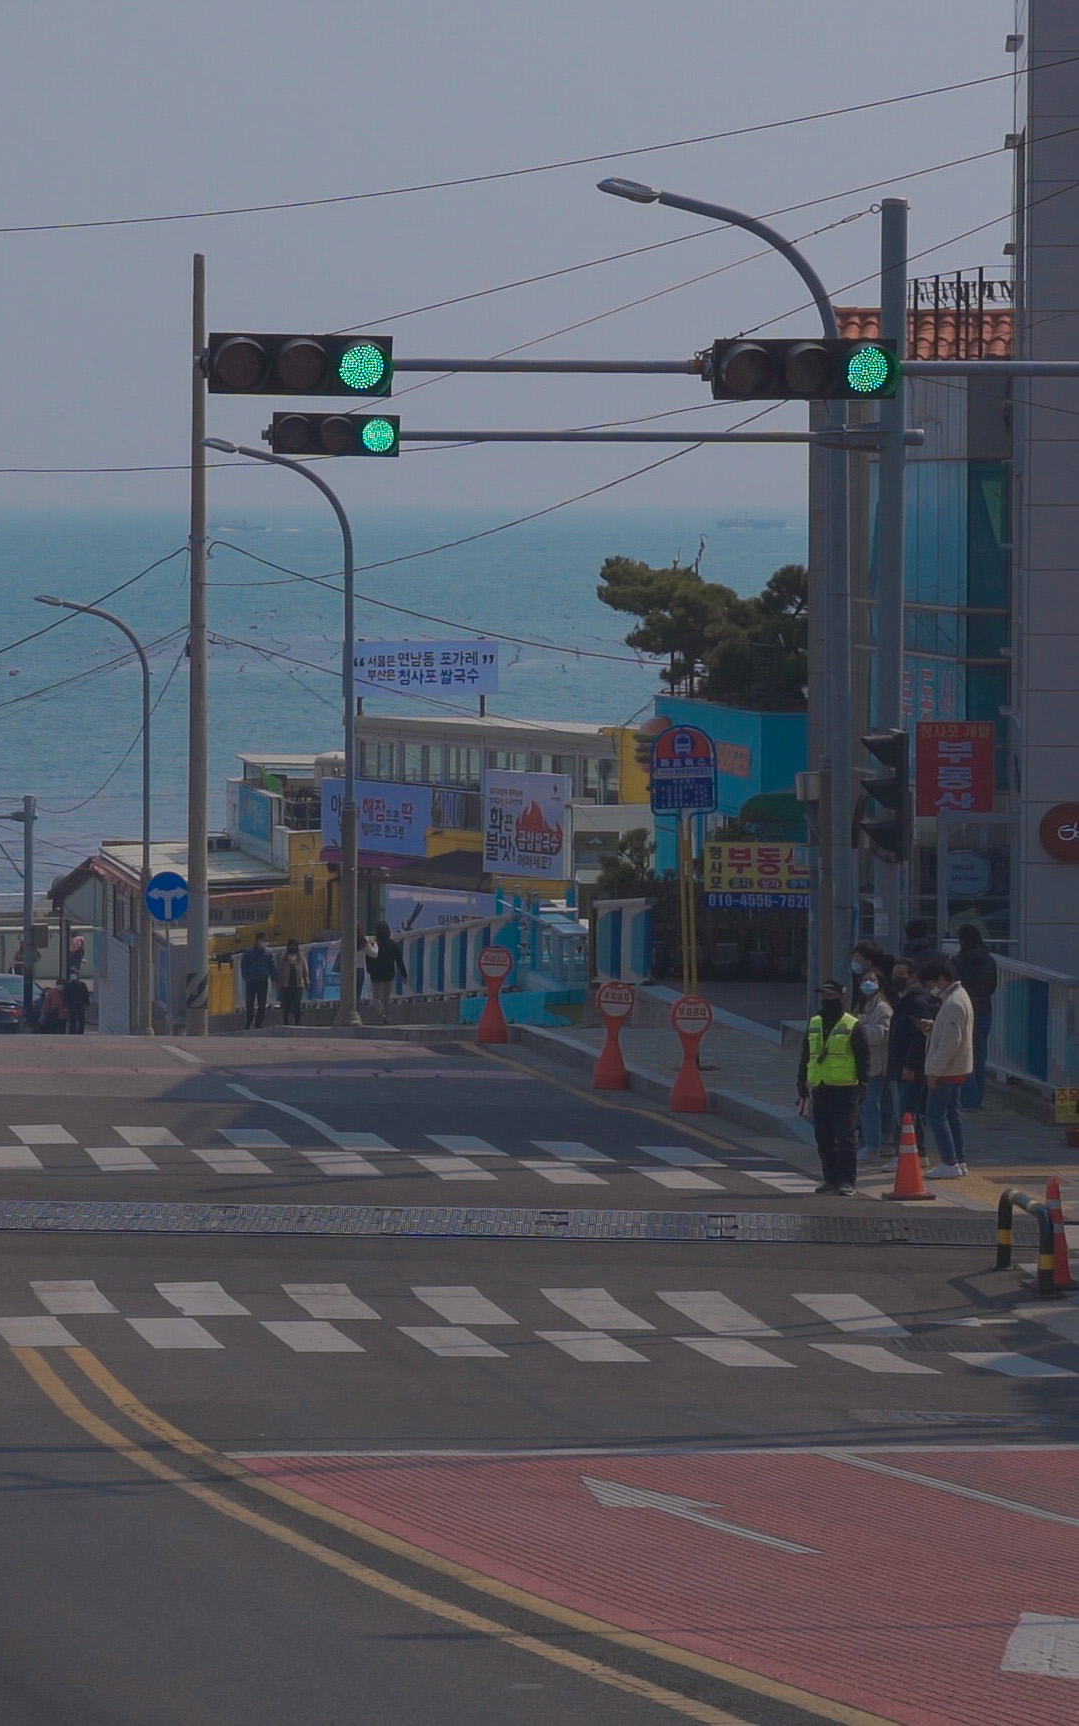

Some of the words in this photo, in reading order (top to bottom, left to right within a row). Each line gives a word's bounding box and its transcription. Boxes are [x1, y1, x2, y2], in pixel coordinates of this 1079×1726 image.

[398, 651, 434, 667] 연남동
[367, 669, 396, 682] 부산은
[398, 669, 437, 685] 청사포
[440, 669, 479, 685] 쌀국수
[966, 725, 991, 738] 개발
[402, 802, 414, 825] 딱
[709, 846, 722, 889] 청사포
[761, 879, 779, 889] 상가
[679, 1007, 706, 1017] 주차금지
